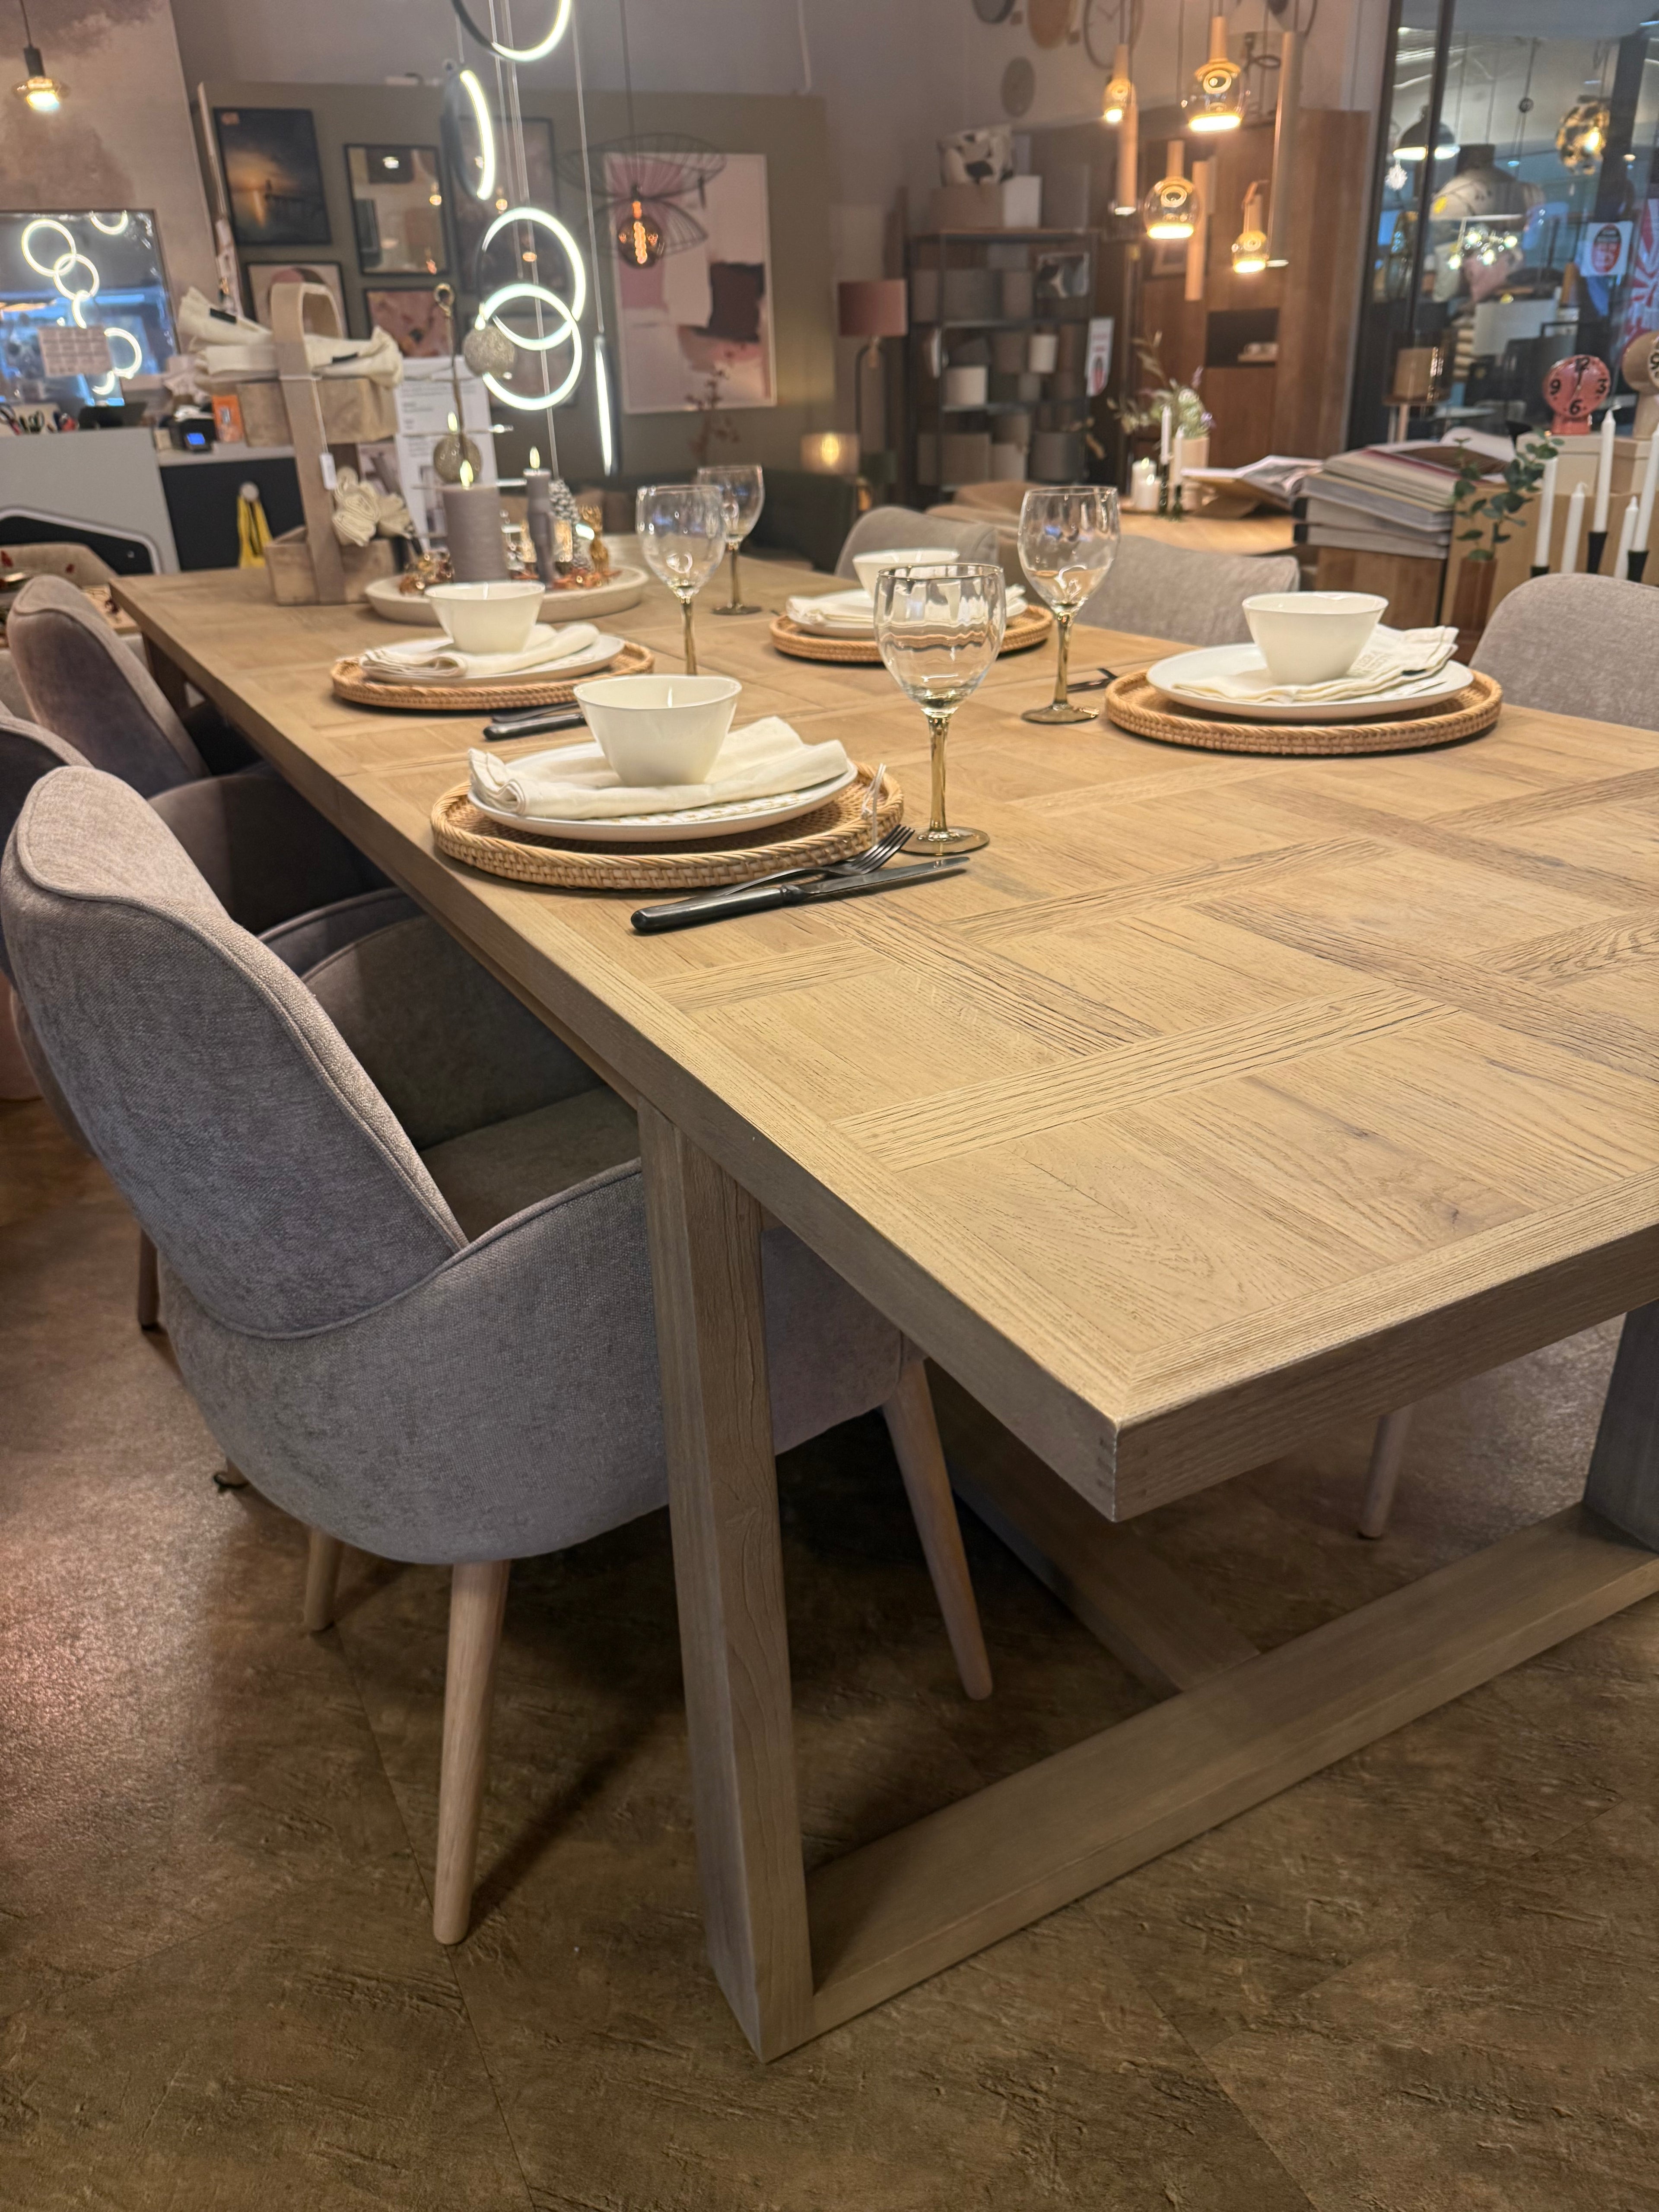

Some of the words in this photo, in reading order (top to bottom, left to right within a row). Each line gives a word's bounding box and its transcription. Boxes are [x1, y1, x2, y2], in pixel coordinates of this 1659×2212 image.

[1550, 378, 1561, 395] 9
[1596, 378, 1607, 394] 3
[1570, 399, 1582, 415] 6
